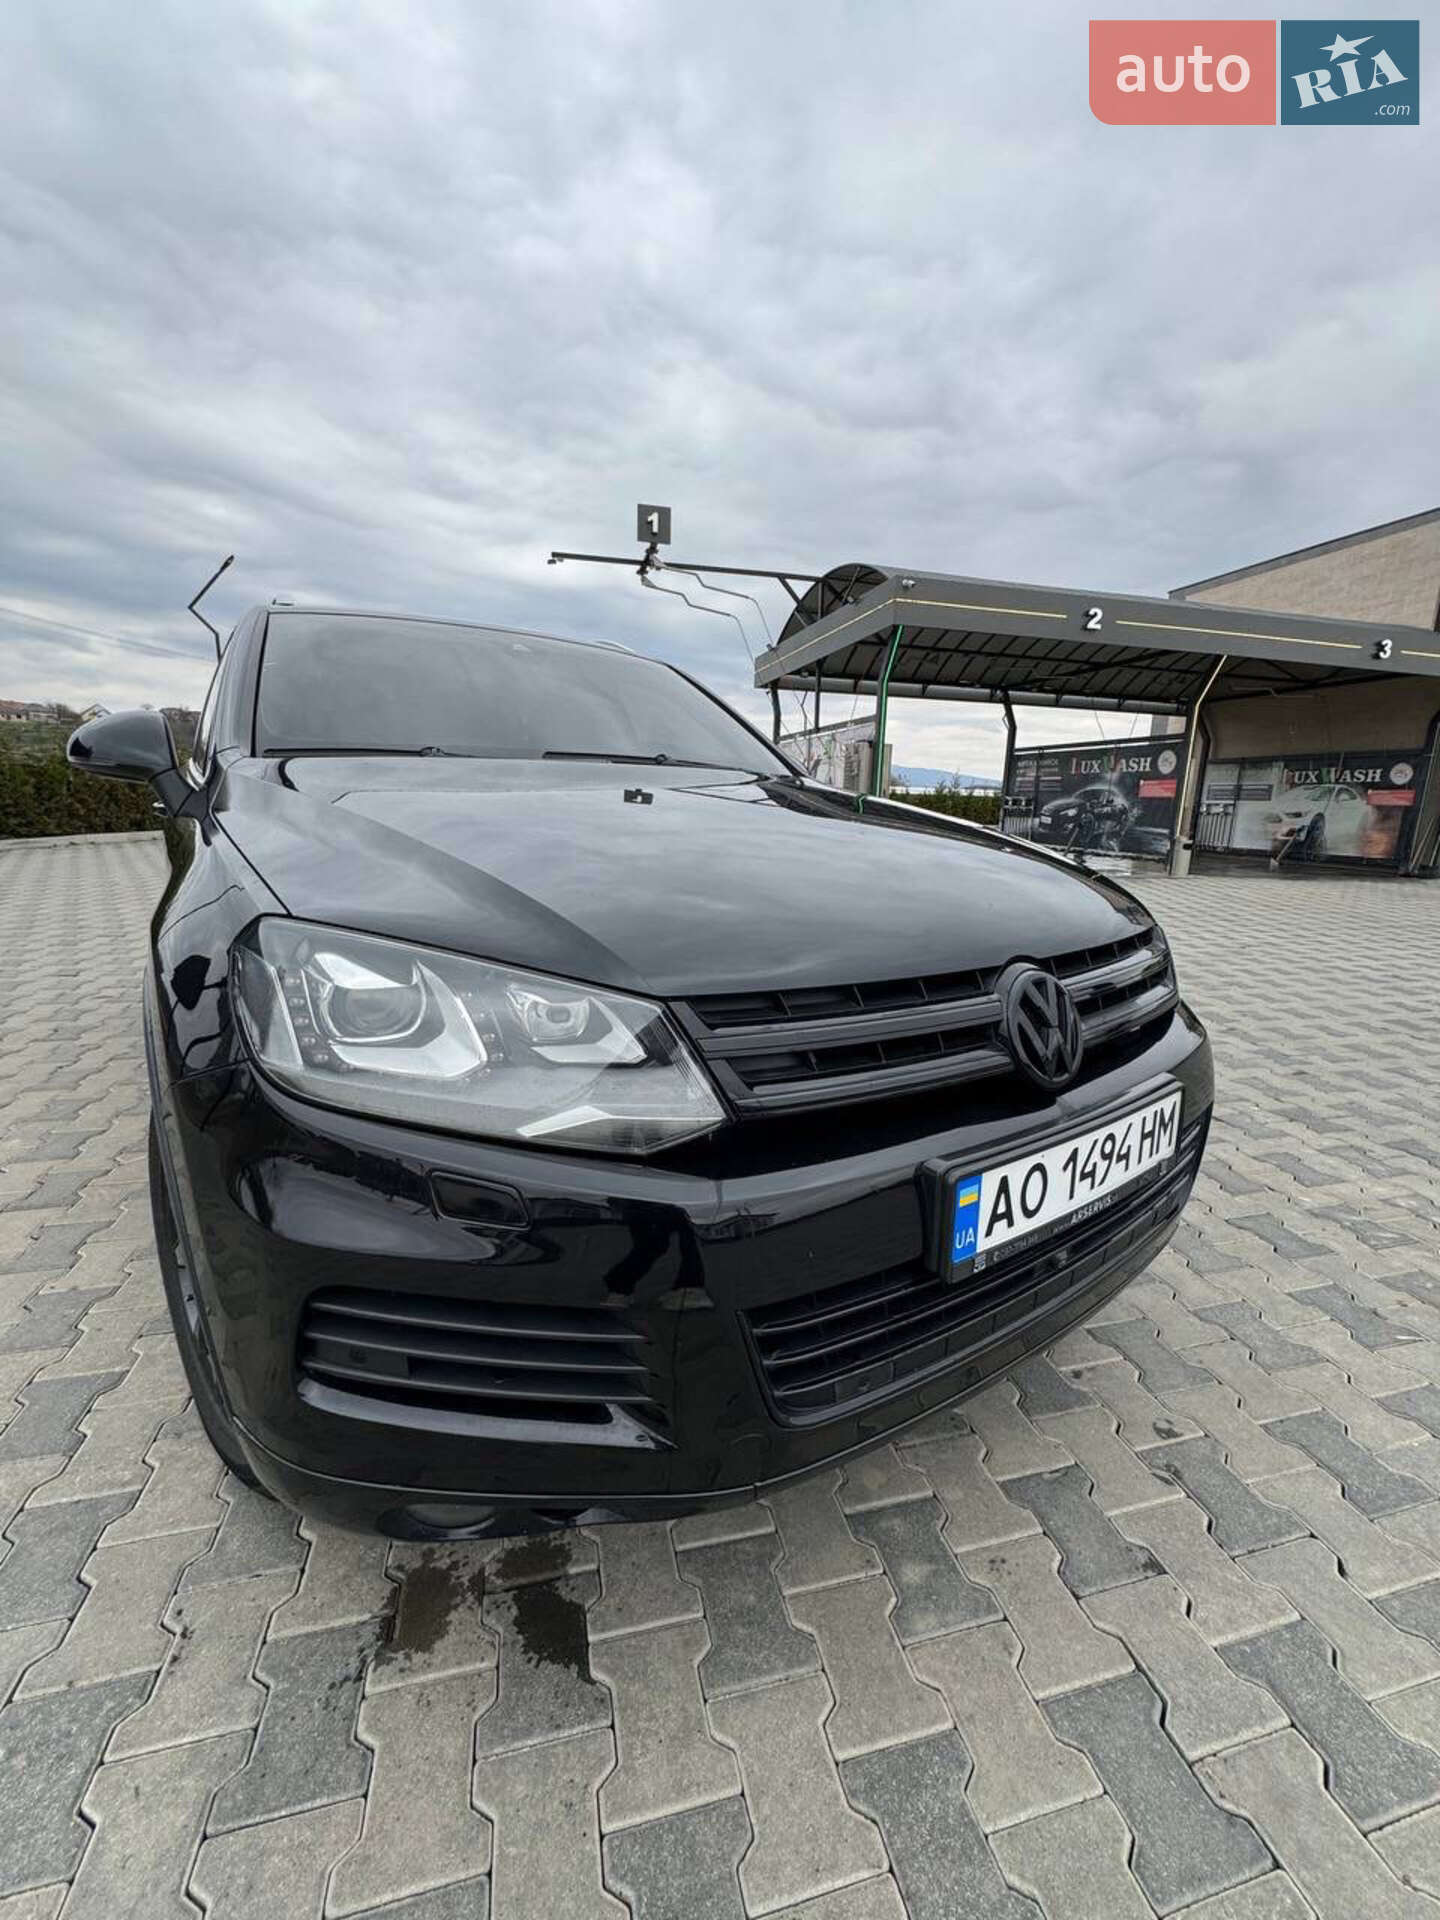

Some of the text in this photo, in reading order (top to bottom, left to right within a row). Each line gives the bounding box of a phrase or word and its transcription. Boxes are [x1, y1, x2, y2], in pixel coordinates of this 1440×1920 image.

[646, 511, 660, 534] 1
[1086, 606, 1104, 631] 2
[1379, 638, 1393, 660] 3
[983, 1100, 1178, 1239] AO 1494 HM
[954, 1227, 976, 1250] UA
